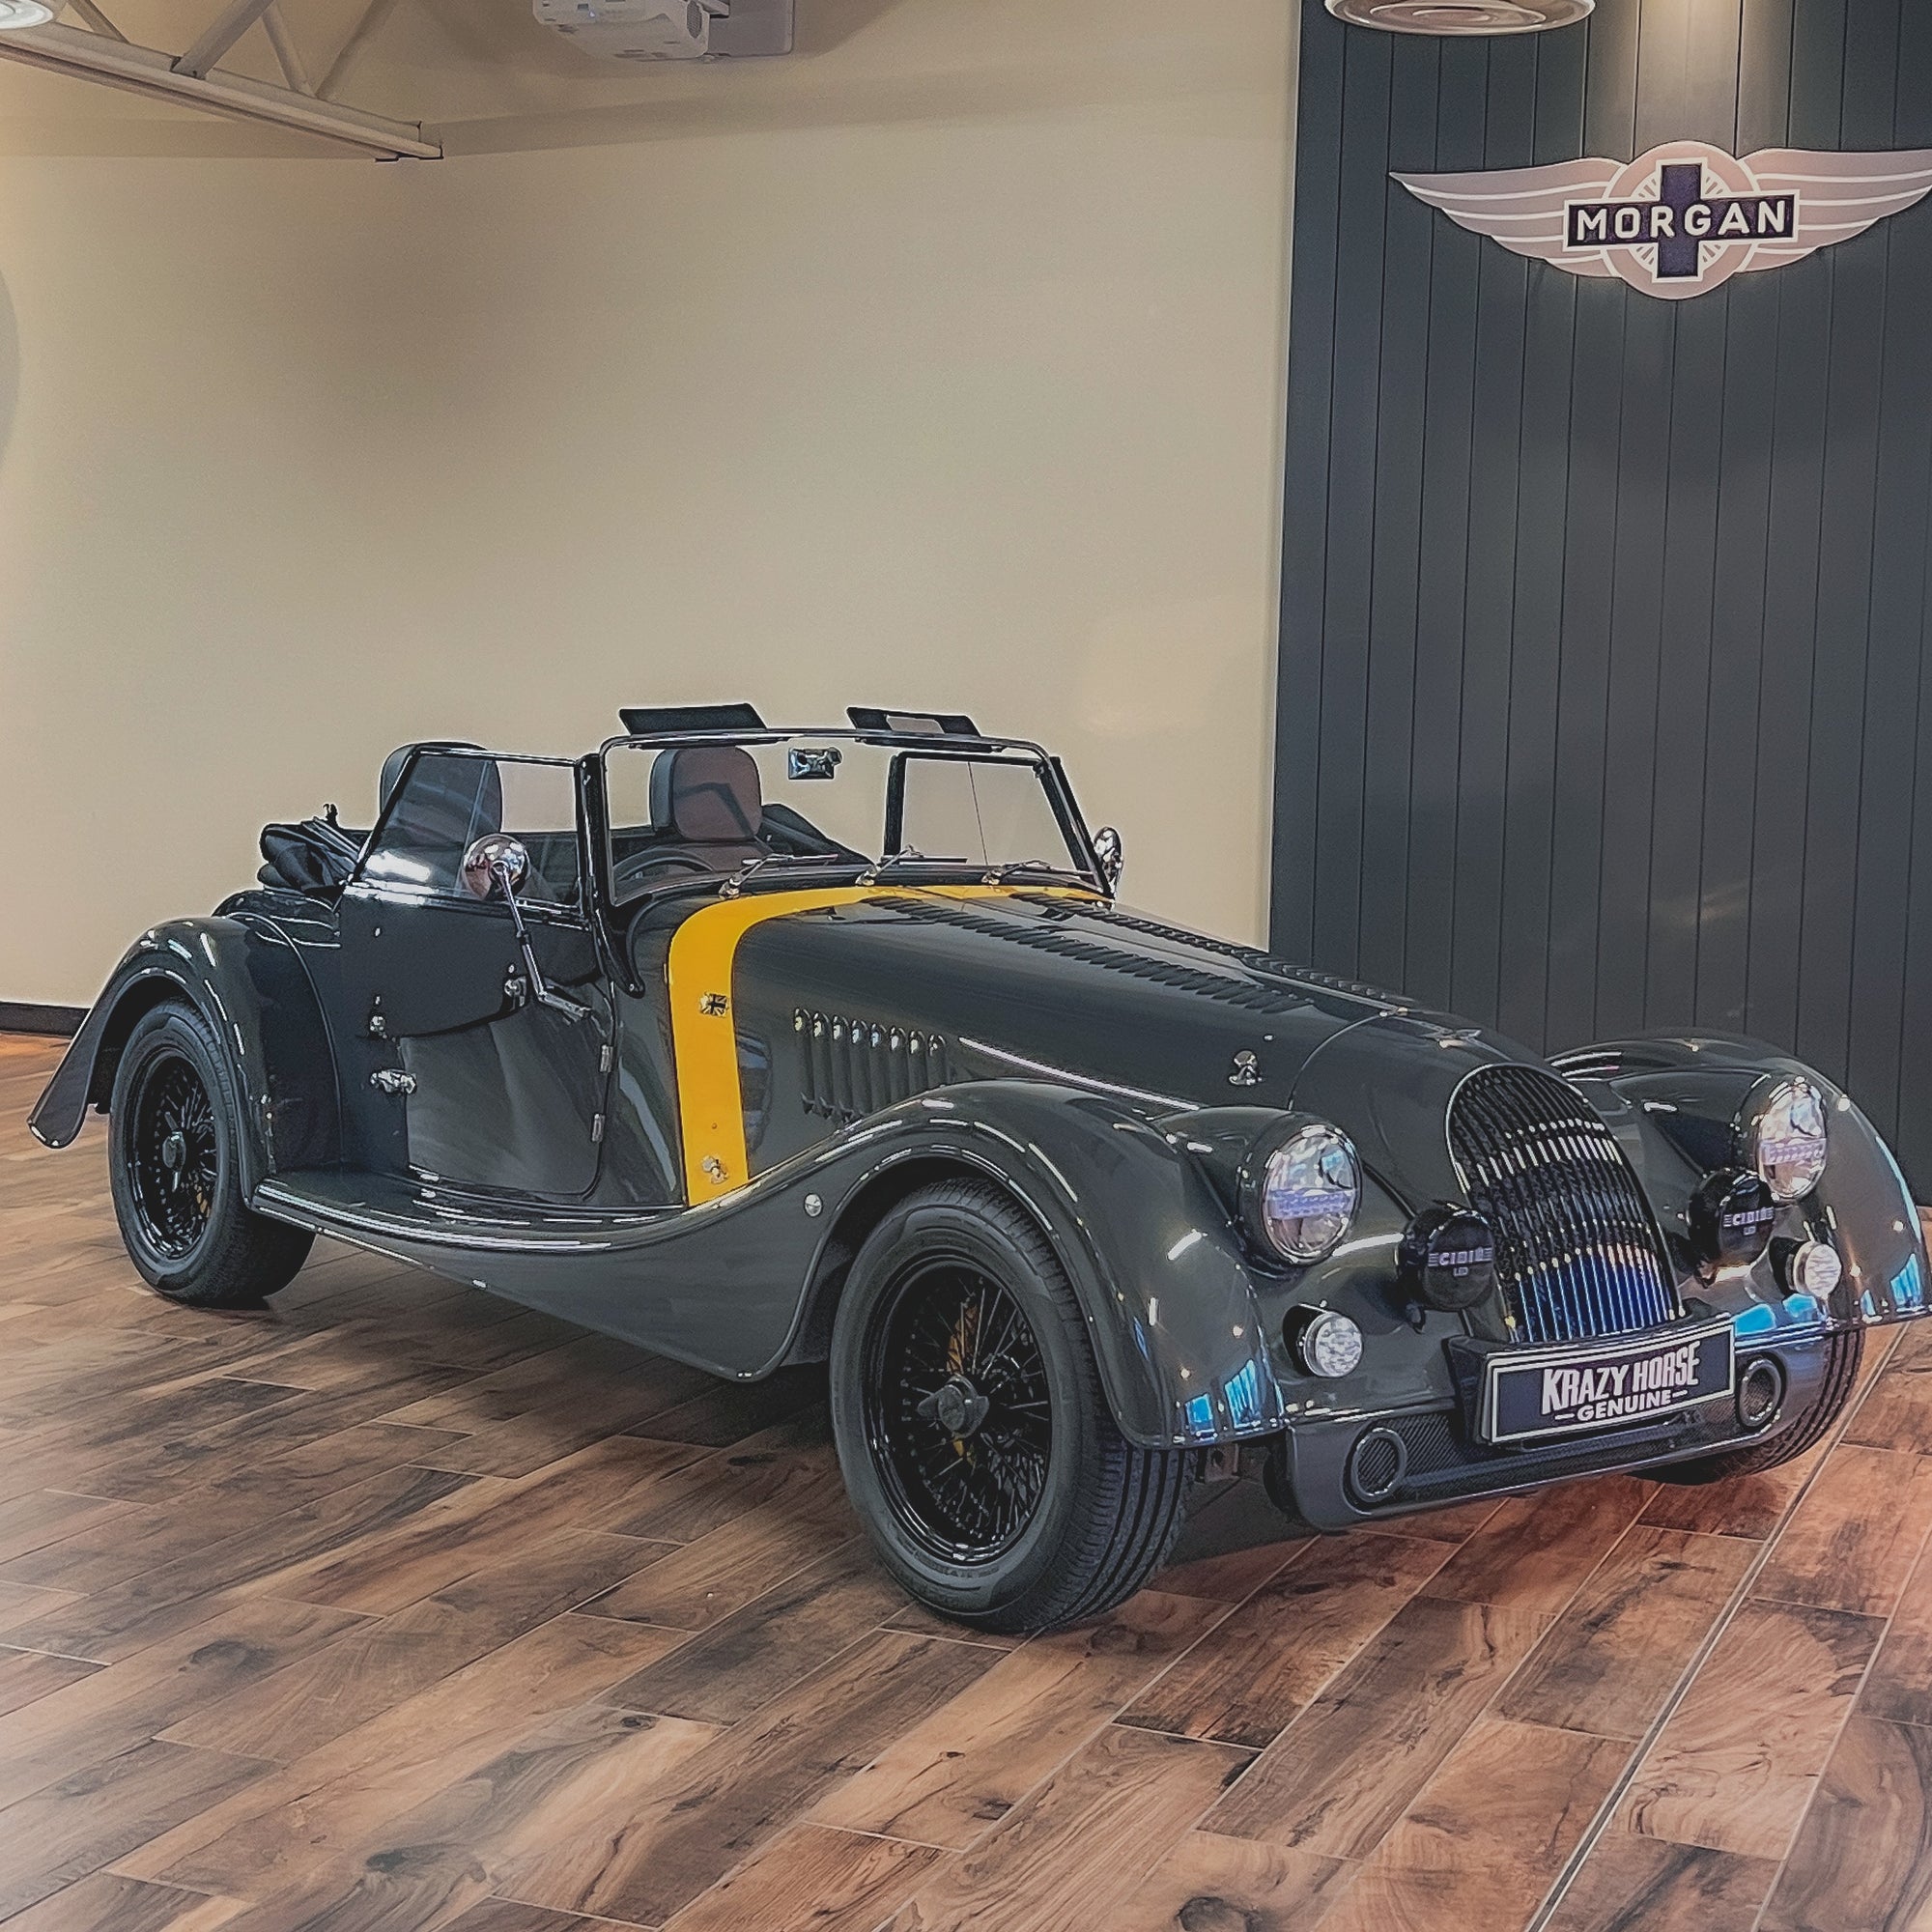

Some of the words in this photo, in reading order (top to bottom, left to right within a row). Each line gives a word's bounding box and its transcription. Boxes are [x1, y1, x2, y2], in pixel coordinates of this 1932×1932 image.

[1577, 200, 1786, 241] MORGAN
[1542, 1363, 1630, 1415] KRAZY
[1632, 1340, 1701, 1393] HORSE
[1577, 1389, 1671, 1422] GENUINE
